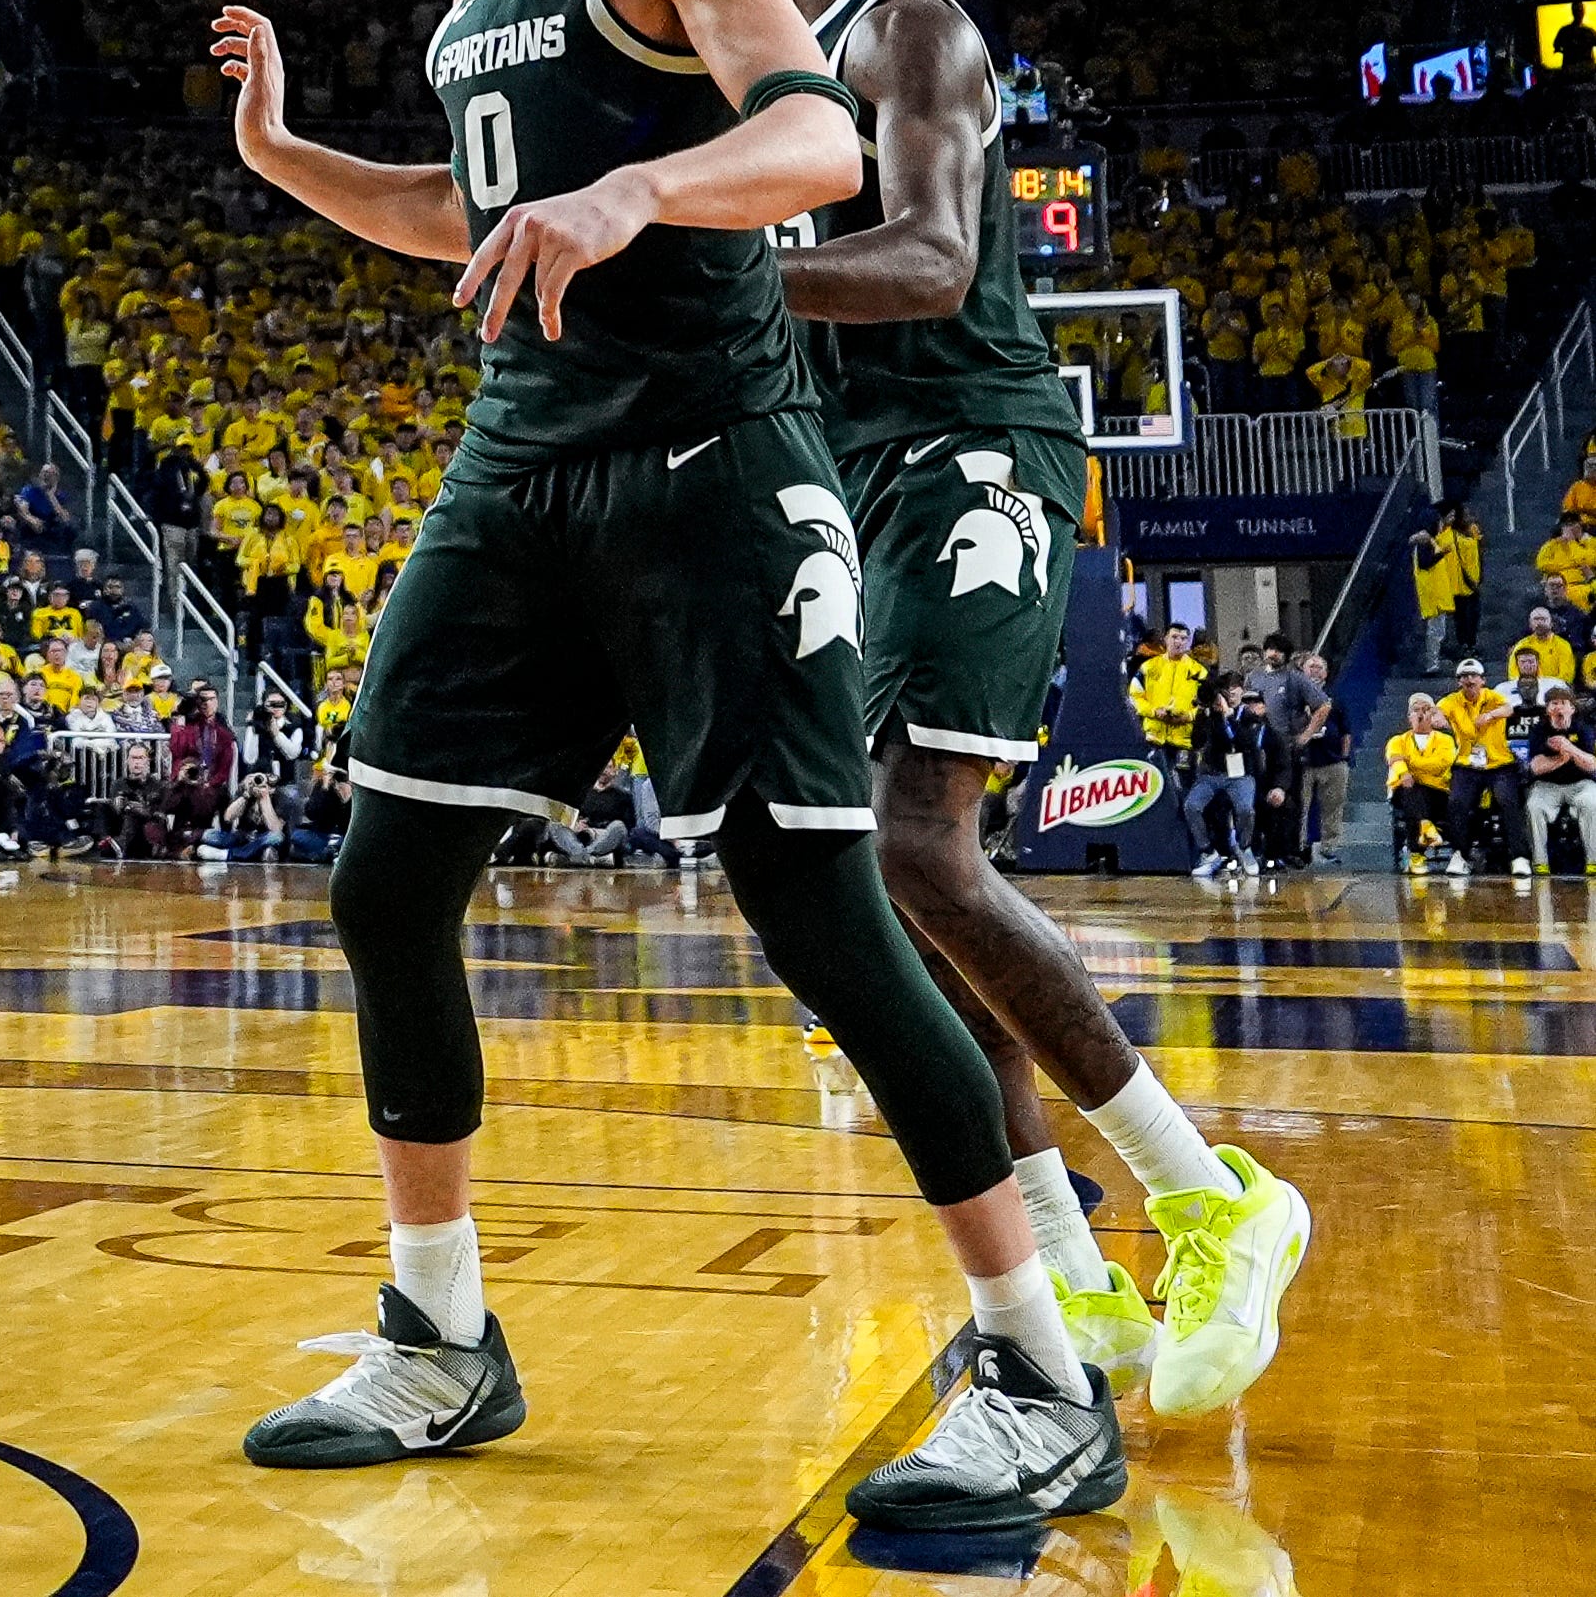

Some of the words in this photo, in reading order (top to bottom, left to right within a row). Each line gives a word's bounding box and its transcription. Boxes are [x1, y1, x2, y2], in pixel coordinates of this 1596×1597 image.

[435, 12, 567, 85] SPARTANS
[463, 90, 519, 211] 0
[1011, 167, 1085, 200] 18:14
[1042, 200, 1079, 252] 9
[1138, 519, 1210, 538] FAMILY
[1235, 517, 1318, 536] TUNNEL
[47, 615, 74, 631] M
[1043, 770, 1149, 826] LIBMAN
